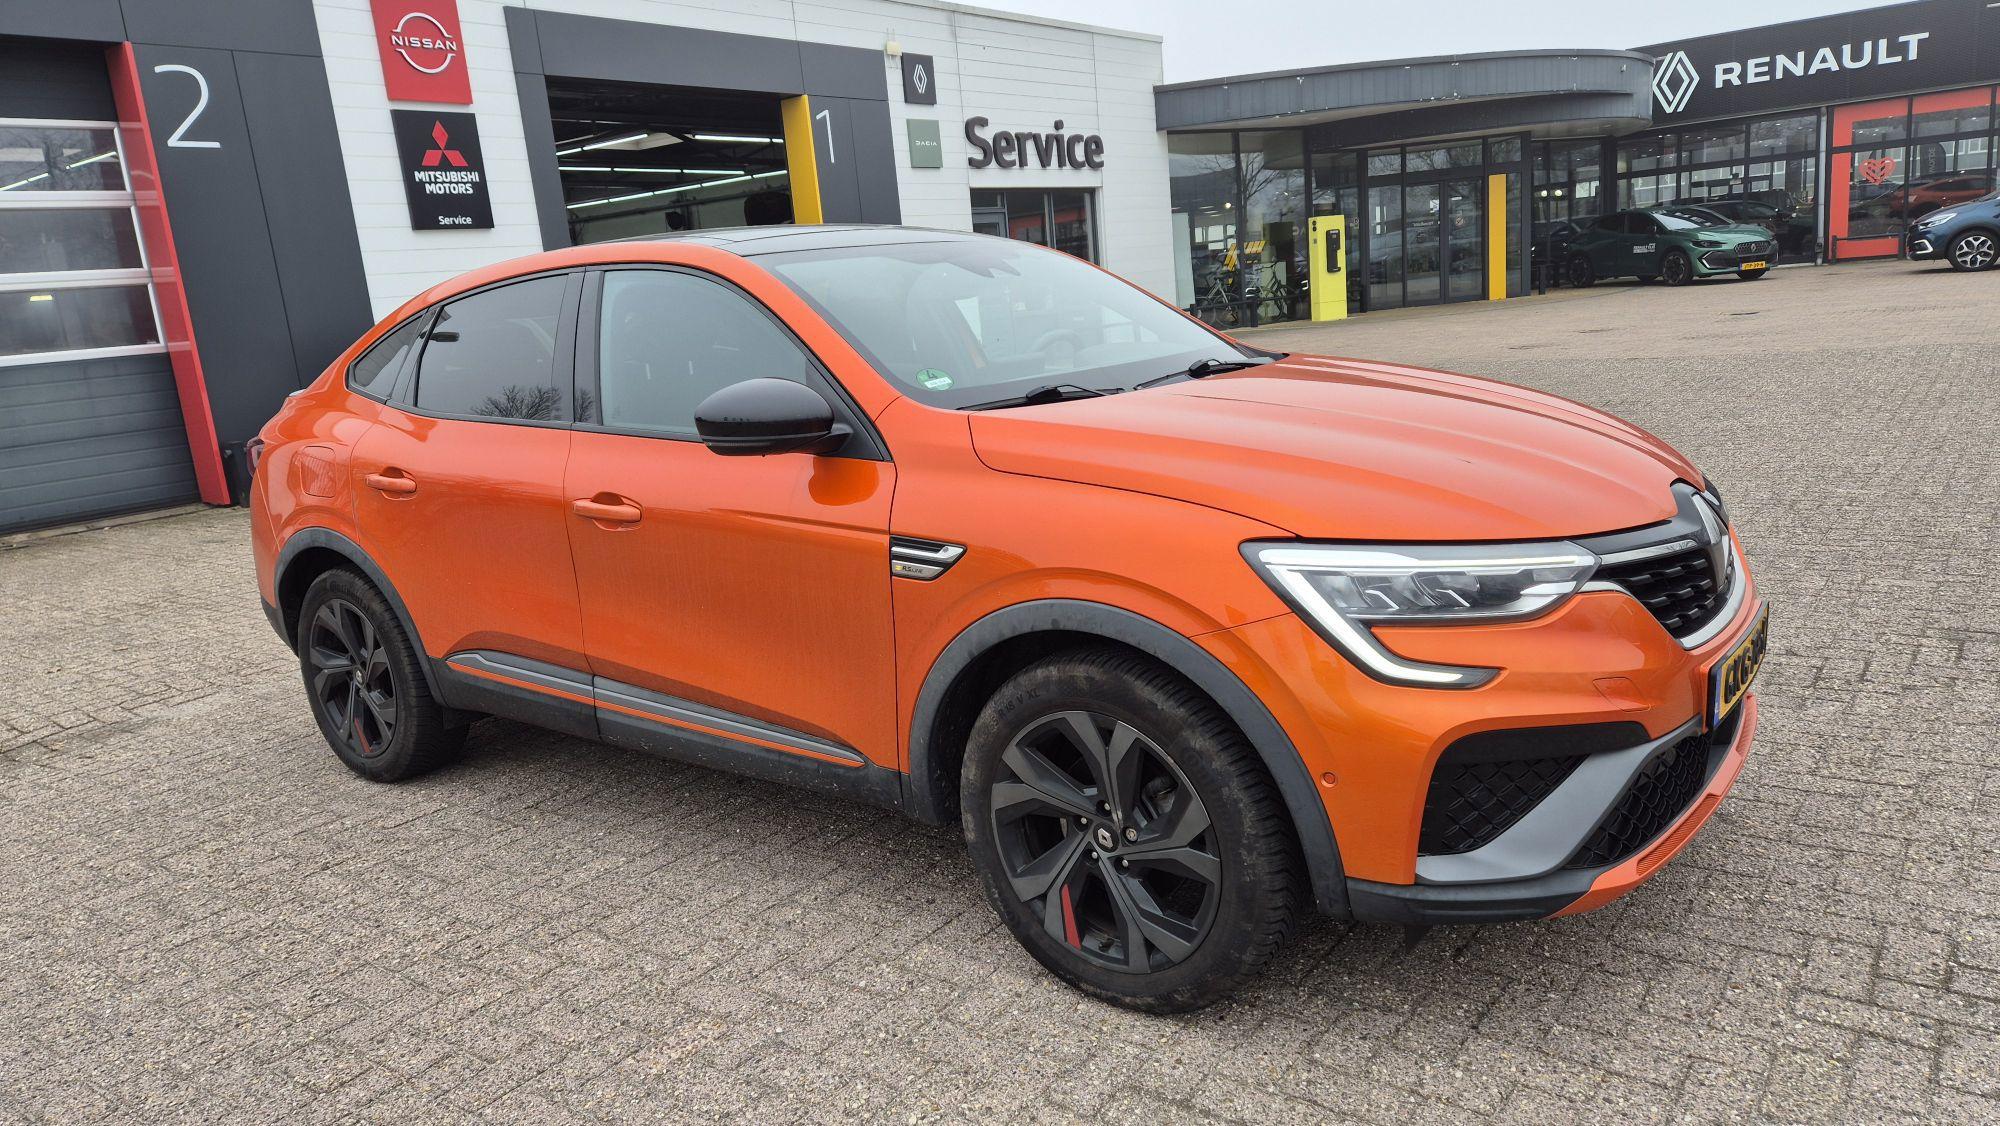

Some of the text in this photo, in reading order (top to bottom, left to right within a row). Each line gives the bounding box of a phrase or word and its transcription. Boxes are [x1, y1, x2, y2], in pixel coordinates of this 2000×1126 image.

[391, 34, 457, 51] NISSAN
[1714, 31, 1930, 89] RENAULT
[154, 64, 221, 148] 2
[816, 109, 835, 163] 1
[965, 116, 1104, 169] Service
[414, 171, 480, 182] MITSUBISHI
[425, 183, 474, 194] MOTORS
[438, 215, 472, 225] Service
